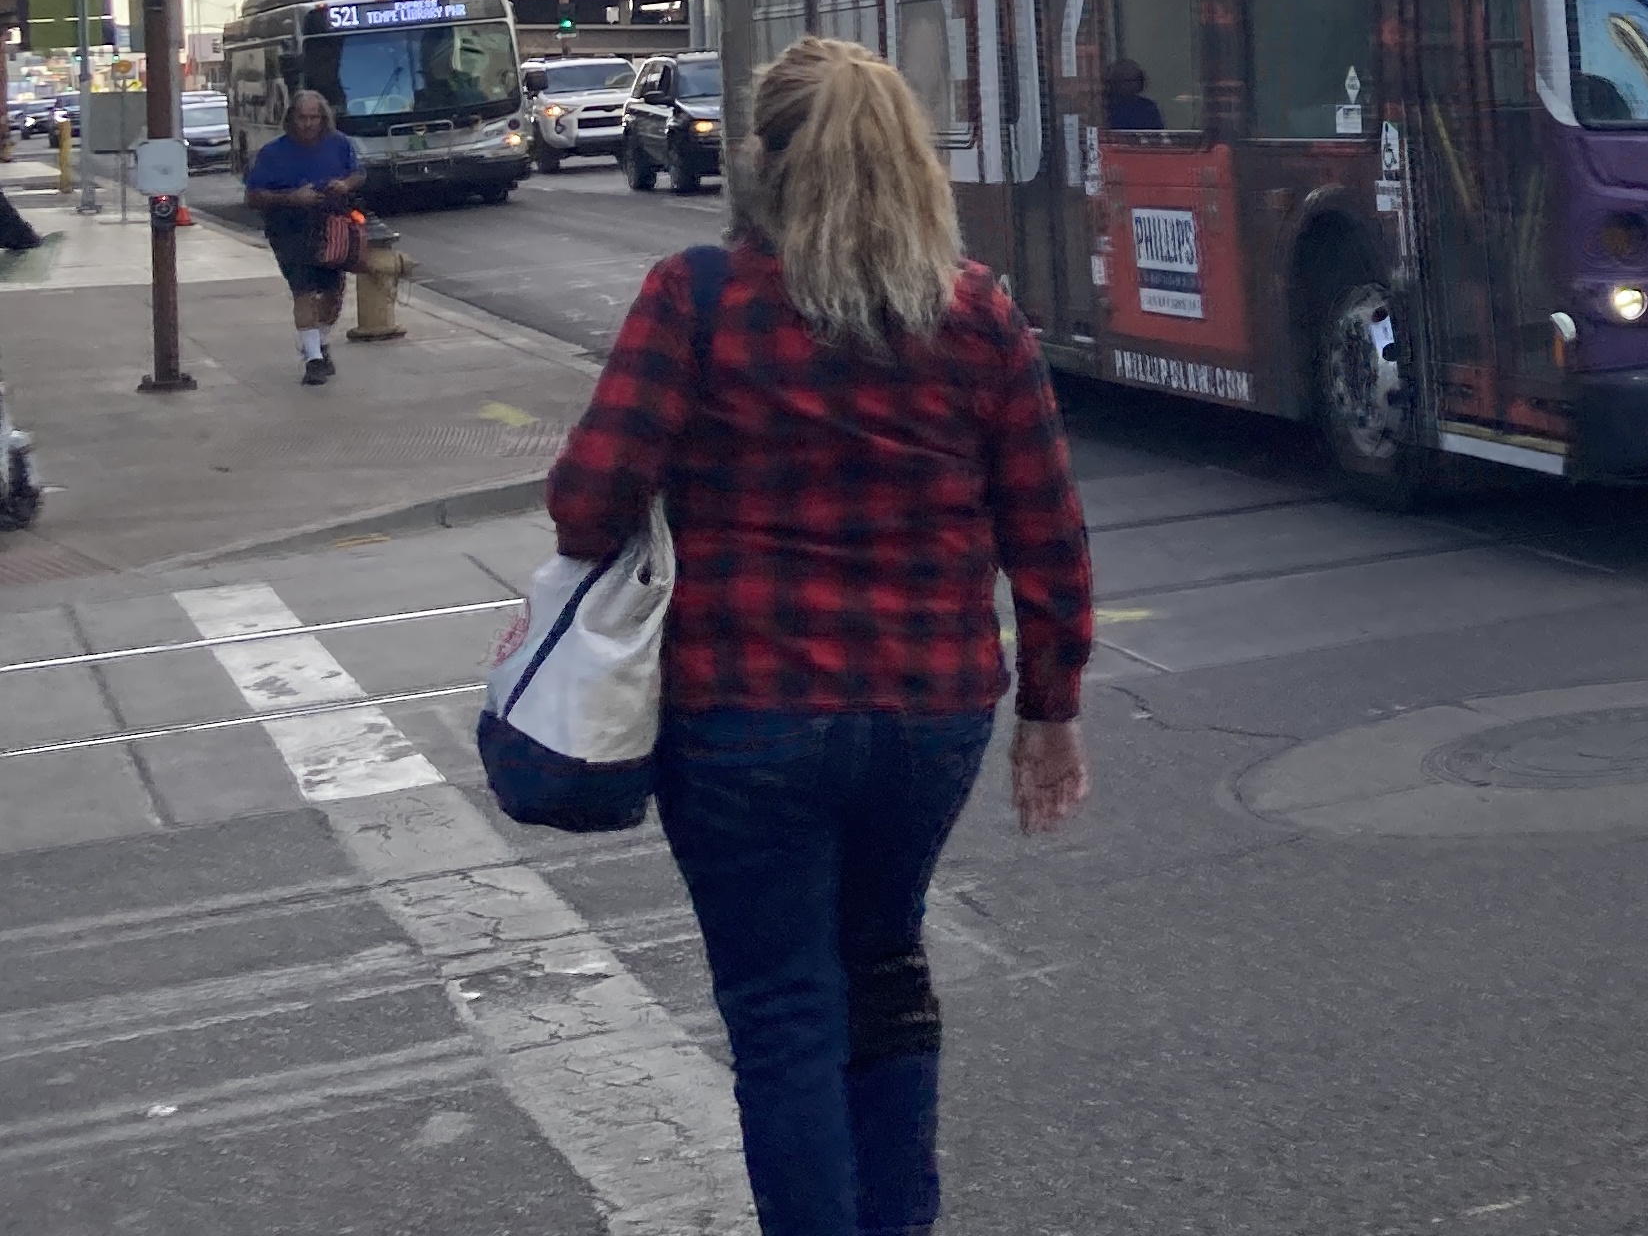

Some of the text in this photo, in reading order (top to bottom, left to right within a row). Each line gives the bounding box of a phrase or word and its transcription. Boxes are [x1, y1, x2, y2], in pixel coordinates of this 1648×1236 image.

[330, 6, 360, 28] 521
[366, 9, 398, 25] TEMPE
[400, 4, 443, 22] LIBRARY
[1134, 216, 1196, 265] PHILLIPS
